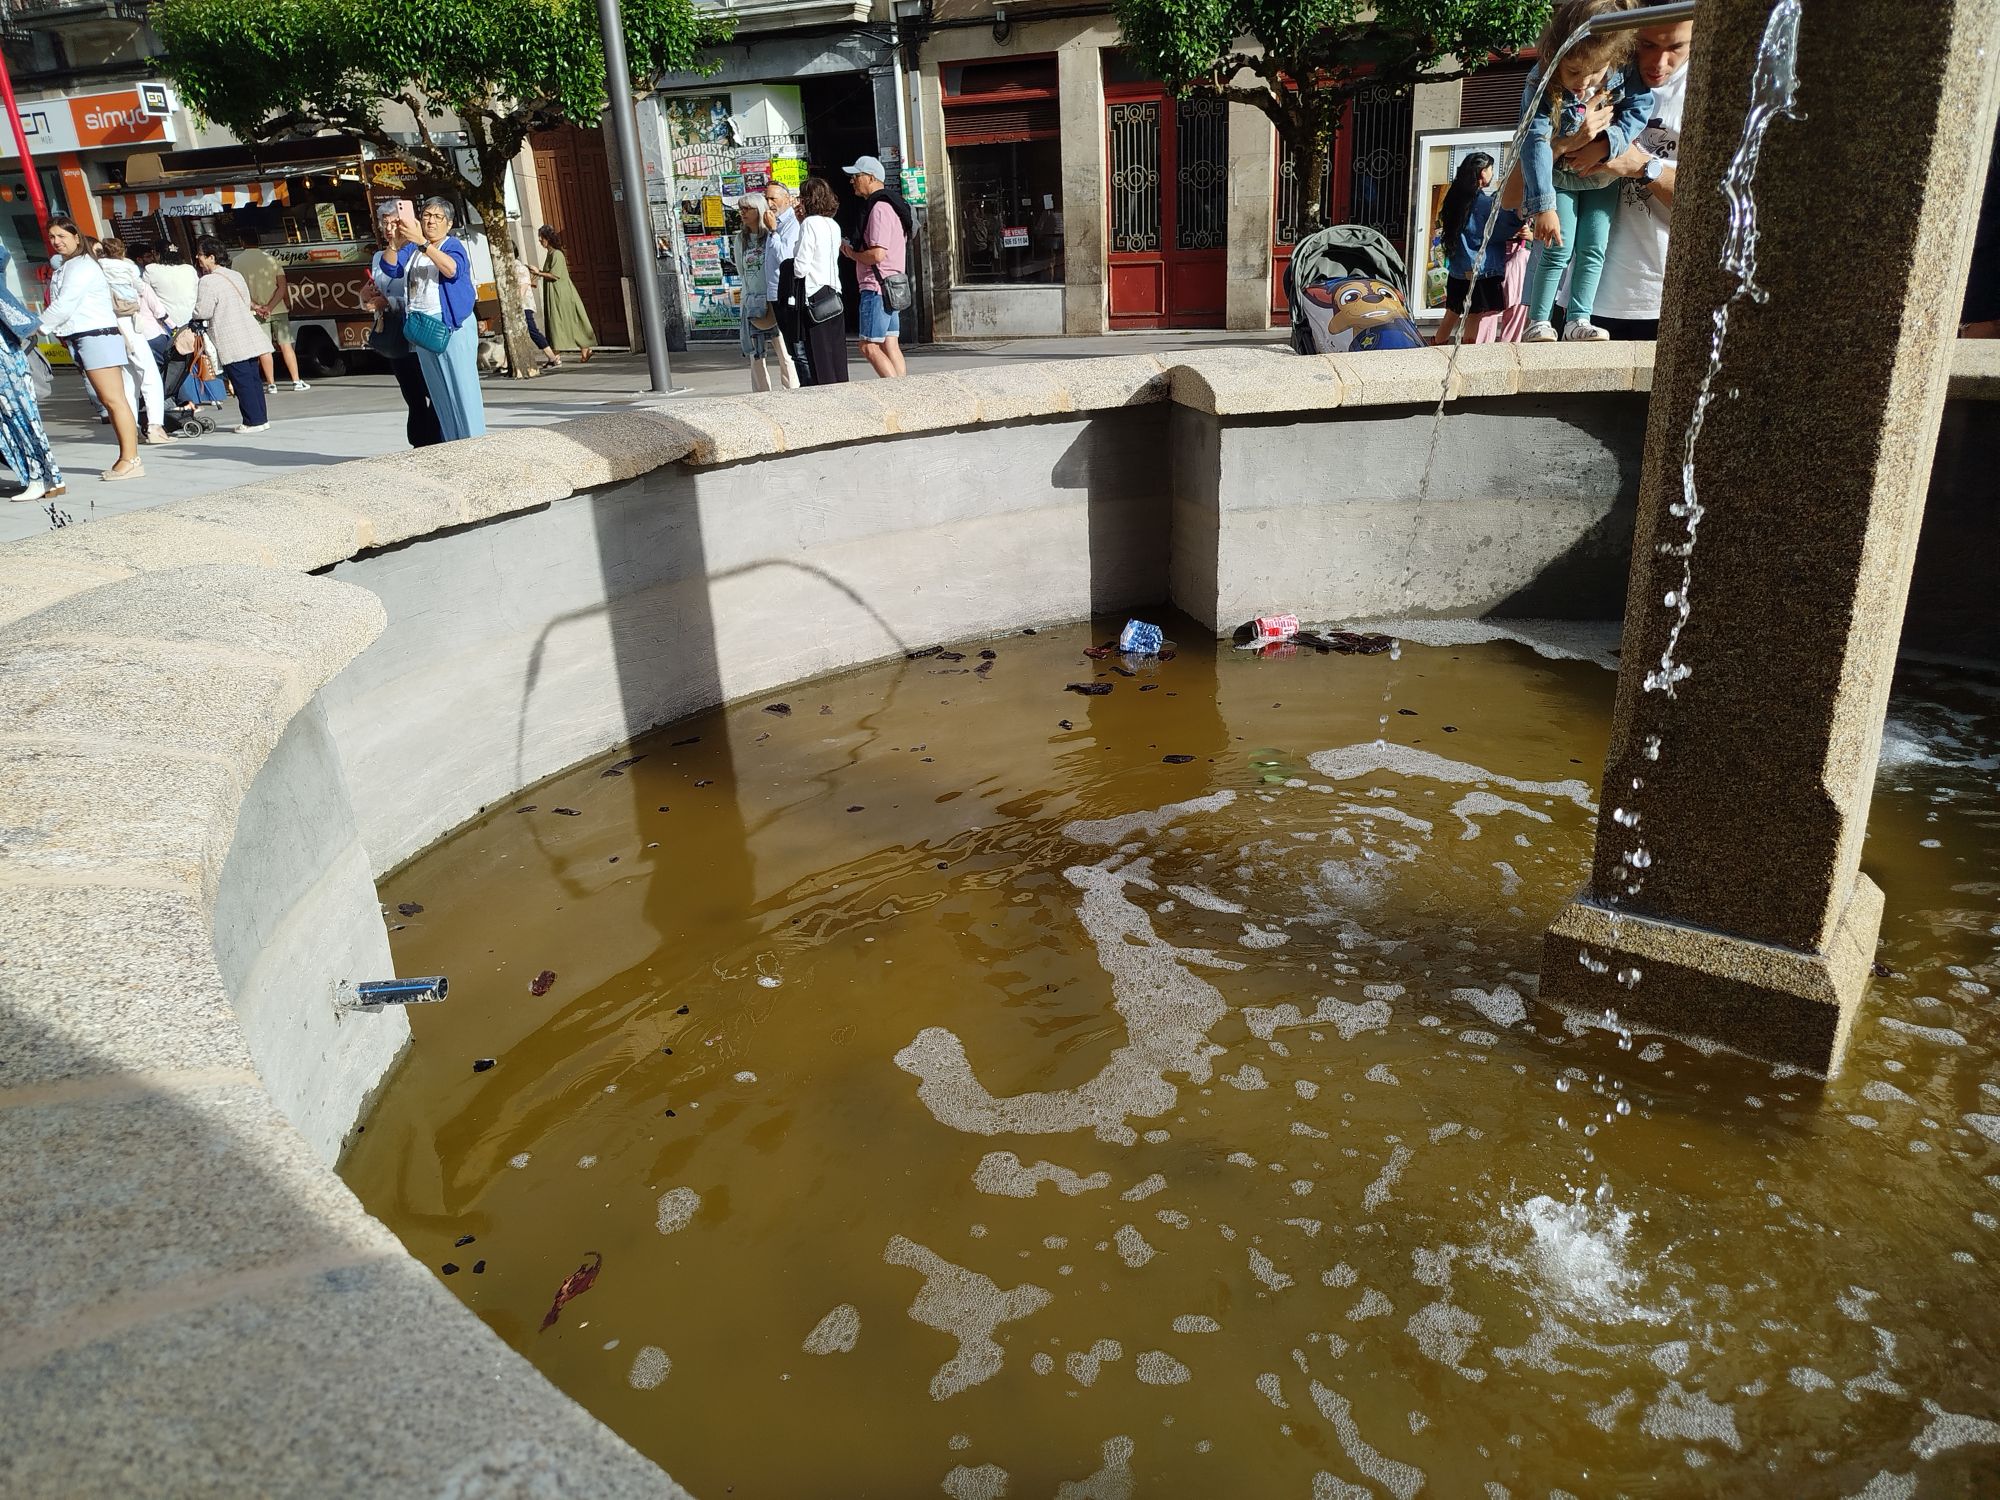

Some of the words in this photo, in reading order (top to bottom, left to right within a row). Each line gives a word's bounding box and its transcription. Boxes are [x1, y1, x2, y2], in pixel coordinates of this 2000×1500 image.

[85, 105, 150, 133] simyo
[672, 143, 736, 161] MOTORISTAS
[64, 169, 81, 179] simyo
[373, 161, 416, 175] CREPES
[1012, 228, 1028, 236] VENDE
